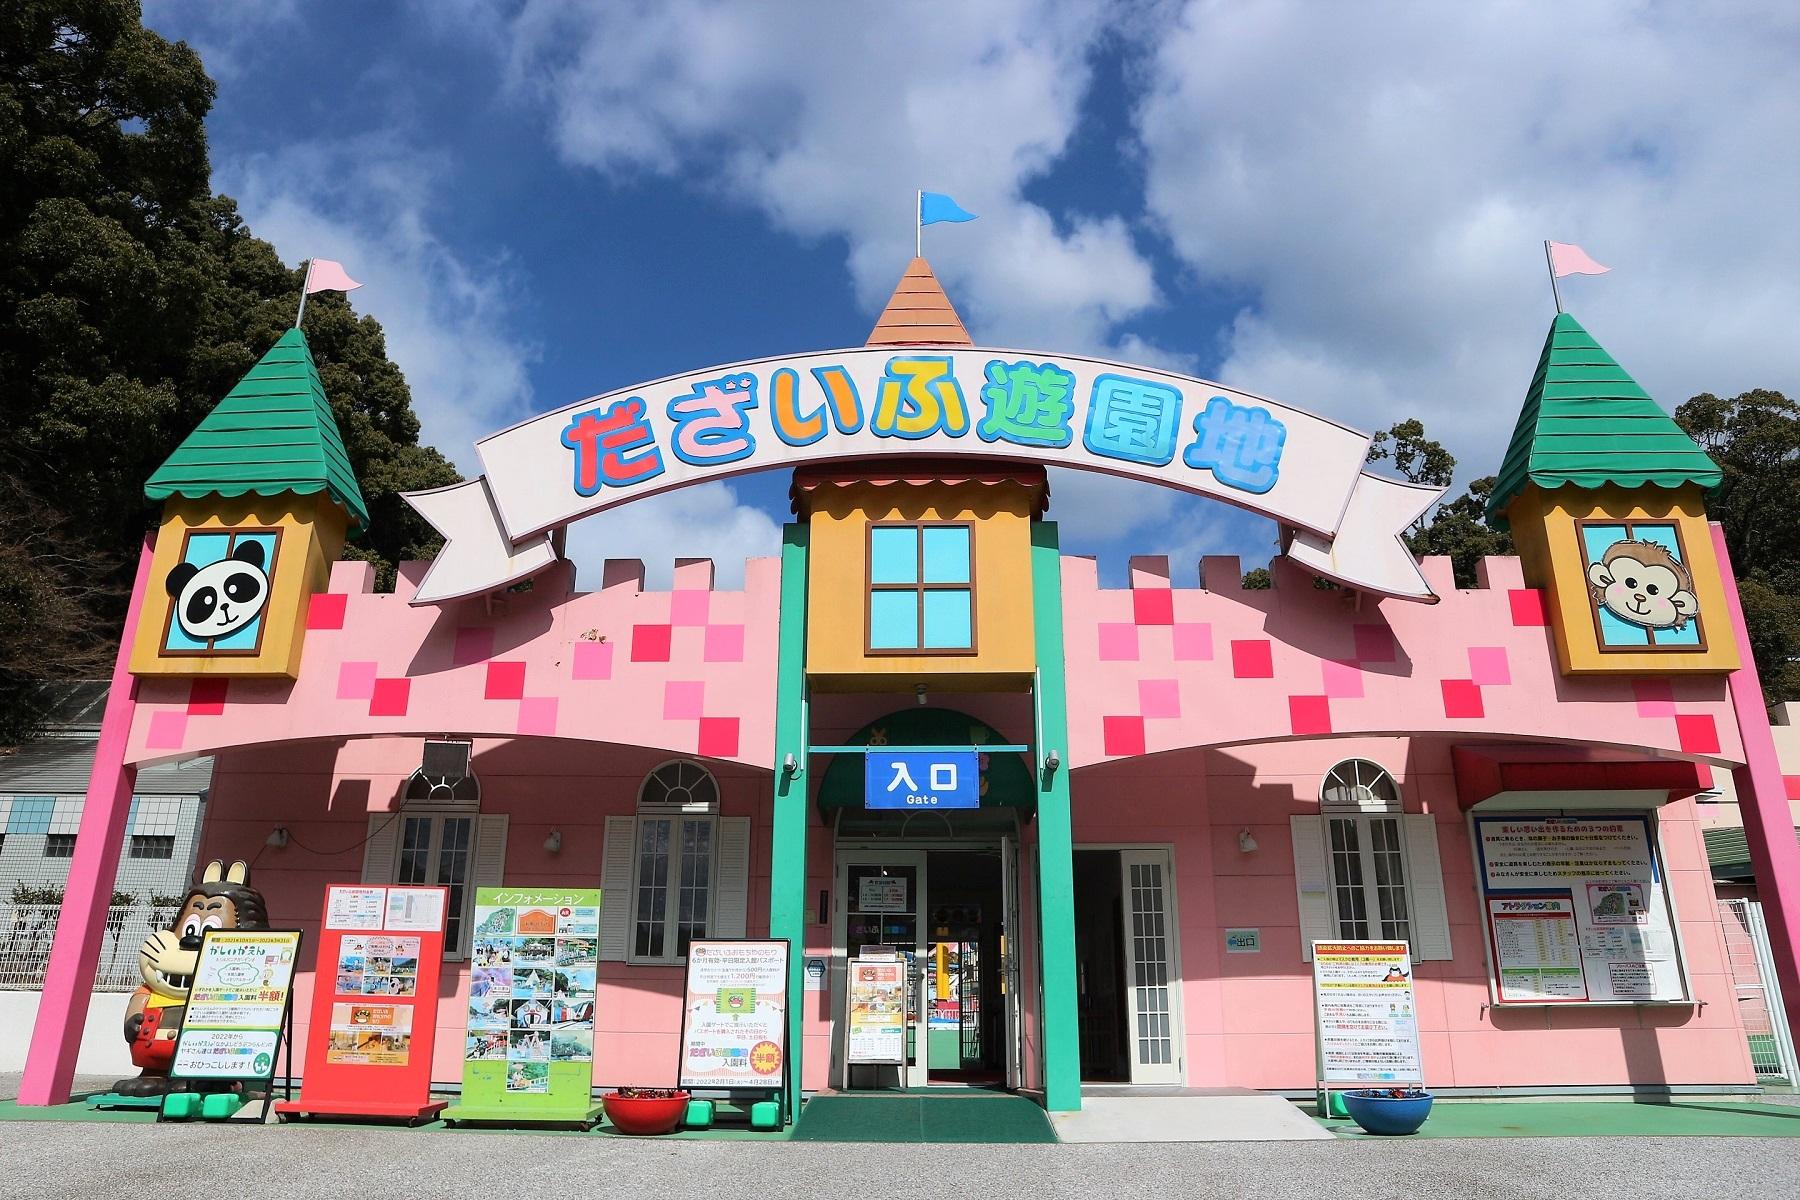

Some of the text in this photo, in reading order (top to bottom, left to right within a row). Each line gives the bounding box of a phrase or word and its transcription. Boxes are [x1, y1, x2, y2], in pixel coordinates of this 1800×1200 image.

[562, 356, 1287, 497] だざいふ遊園地
[887, 762, 958, 792] 入口
[906, 794, 938, 806] Gate
[493, 892, 585, 905] インフォメーション
[1236, 937, 1255, 947] 出口
[721, 1058, 748, 1067] 入園料
